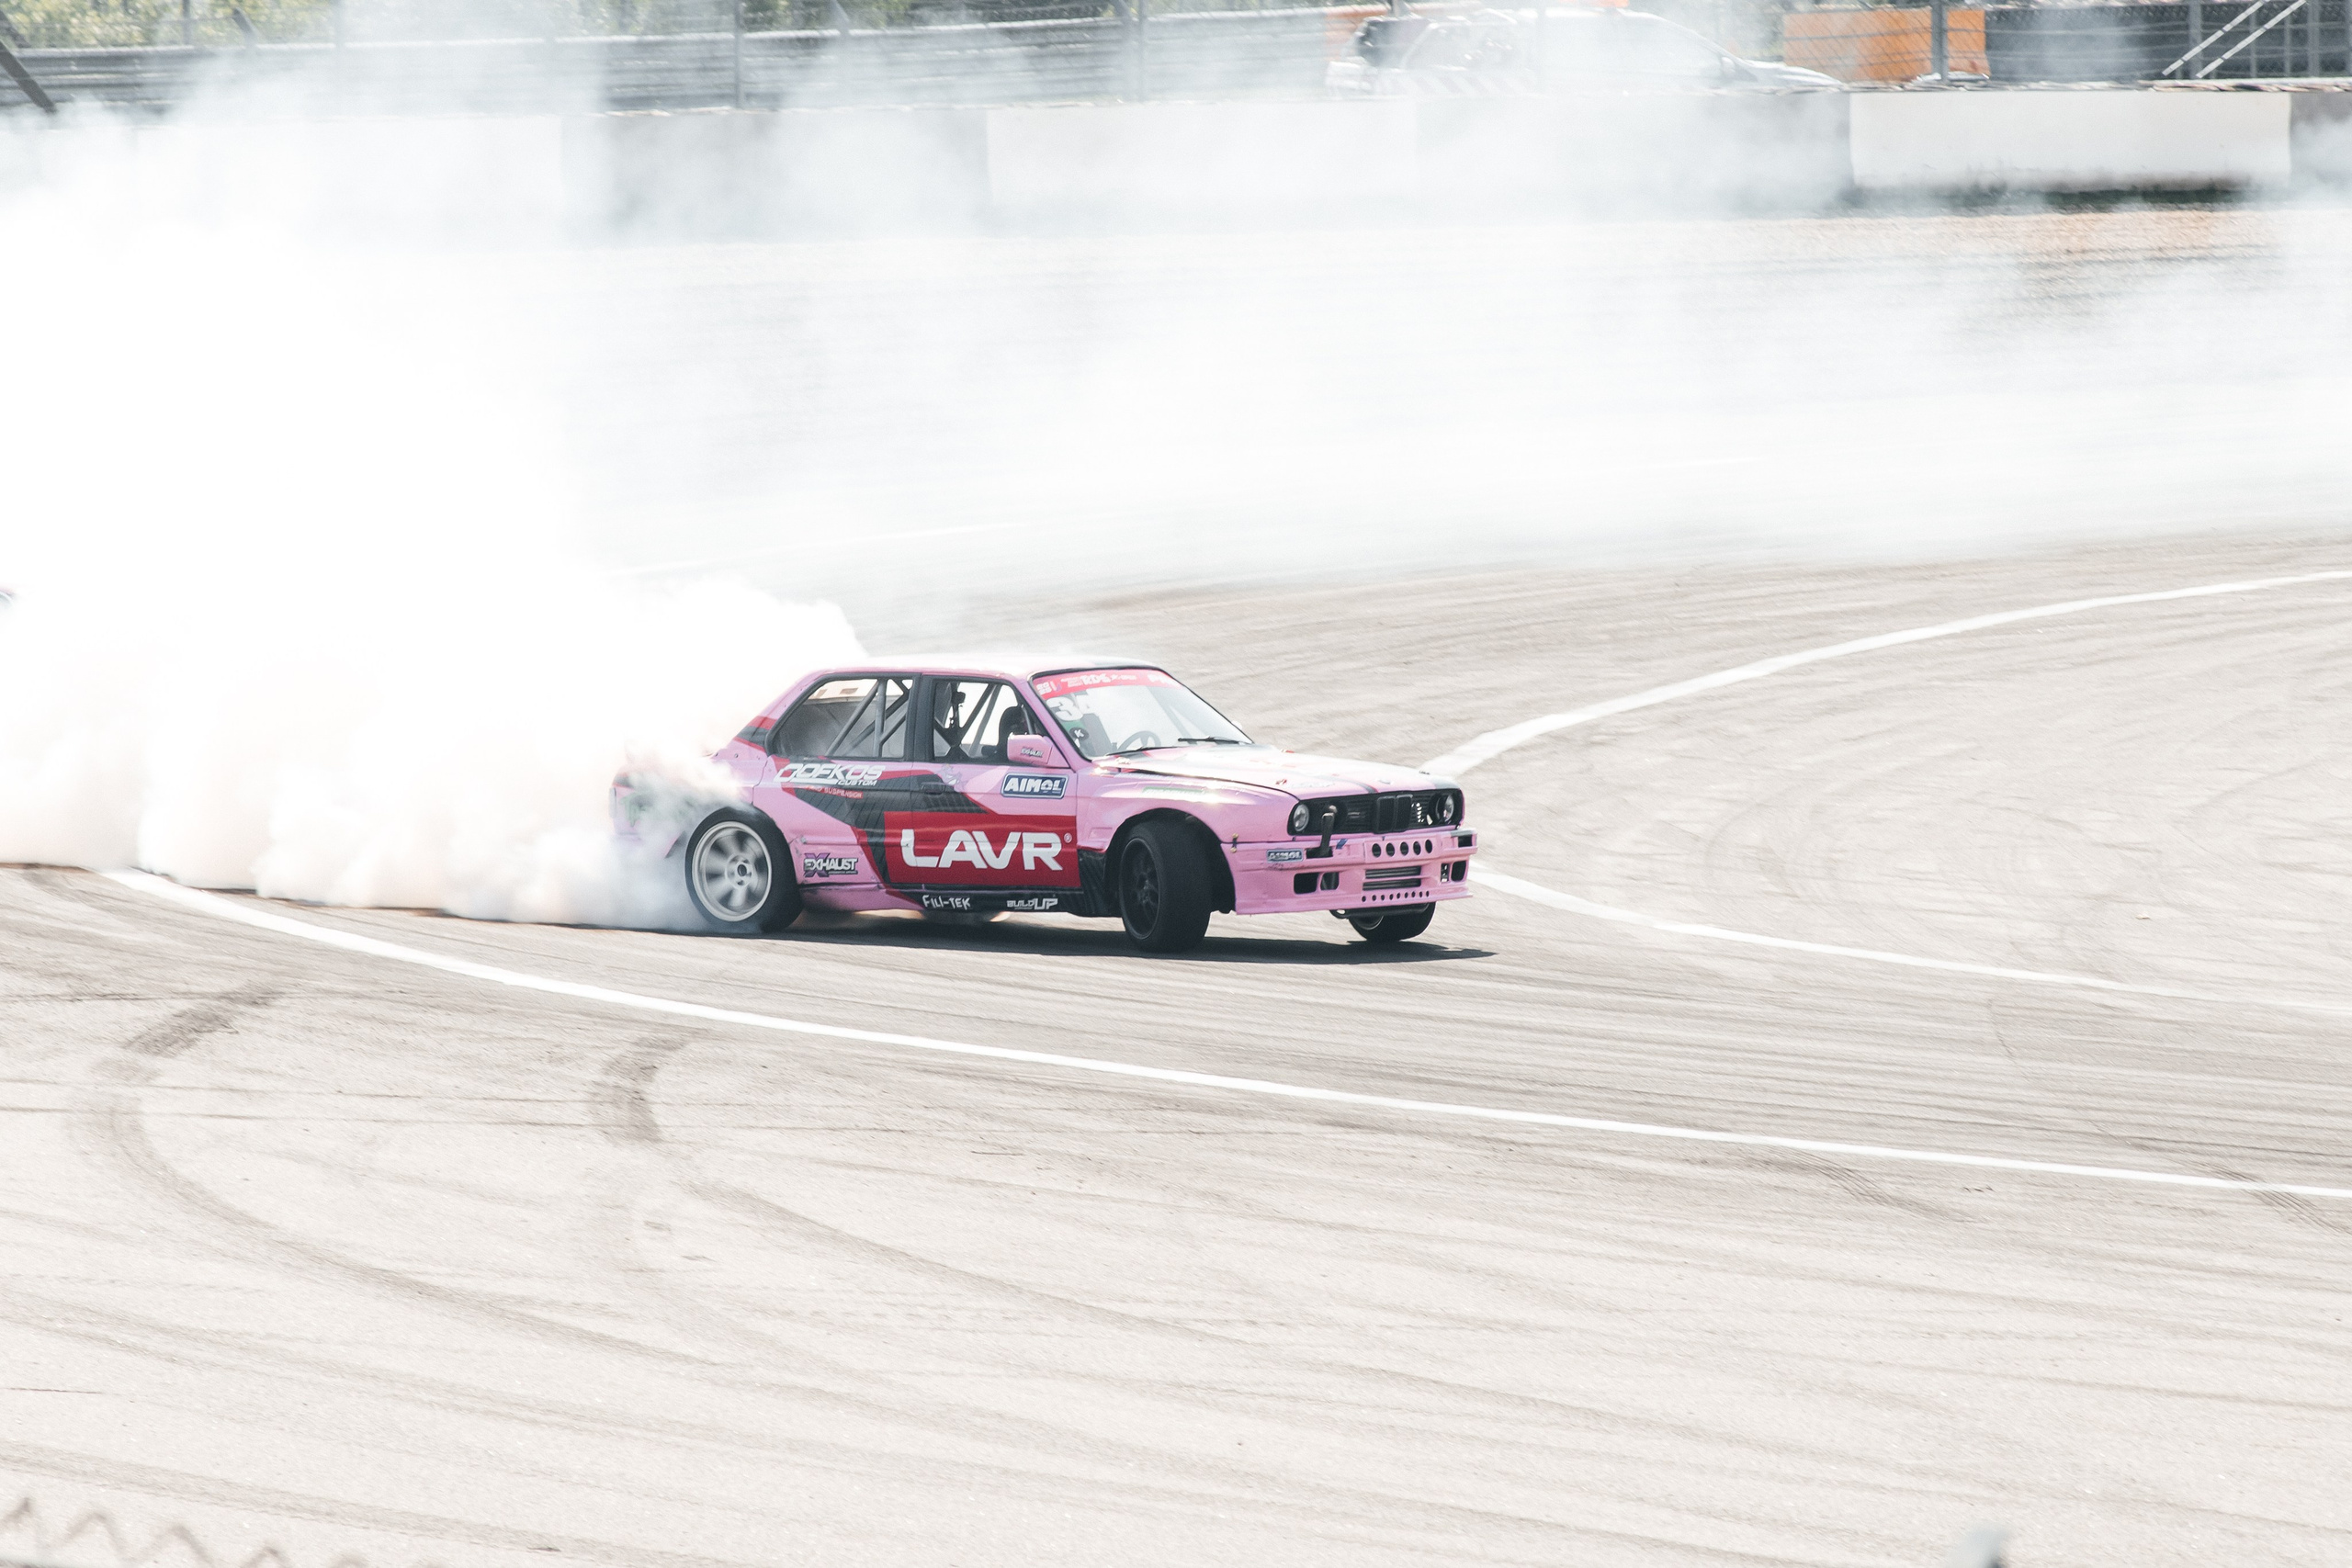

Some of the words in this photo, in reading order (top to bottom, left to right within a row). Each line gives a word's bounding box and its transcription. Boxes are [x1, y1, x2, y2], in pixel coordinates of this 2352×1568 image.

[1004, 777, 1063, 792] AIMOL
[900, 829, 1063, 871] LAVR
[804, 854, 858, 876] EXHAUST
